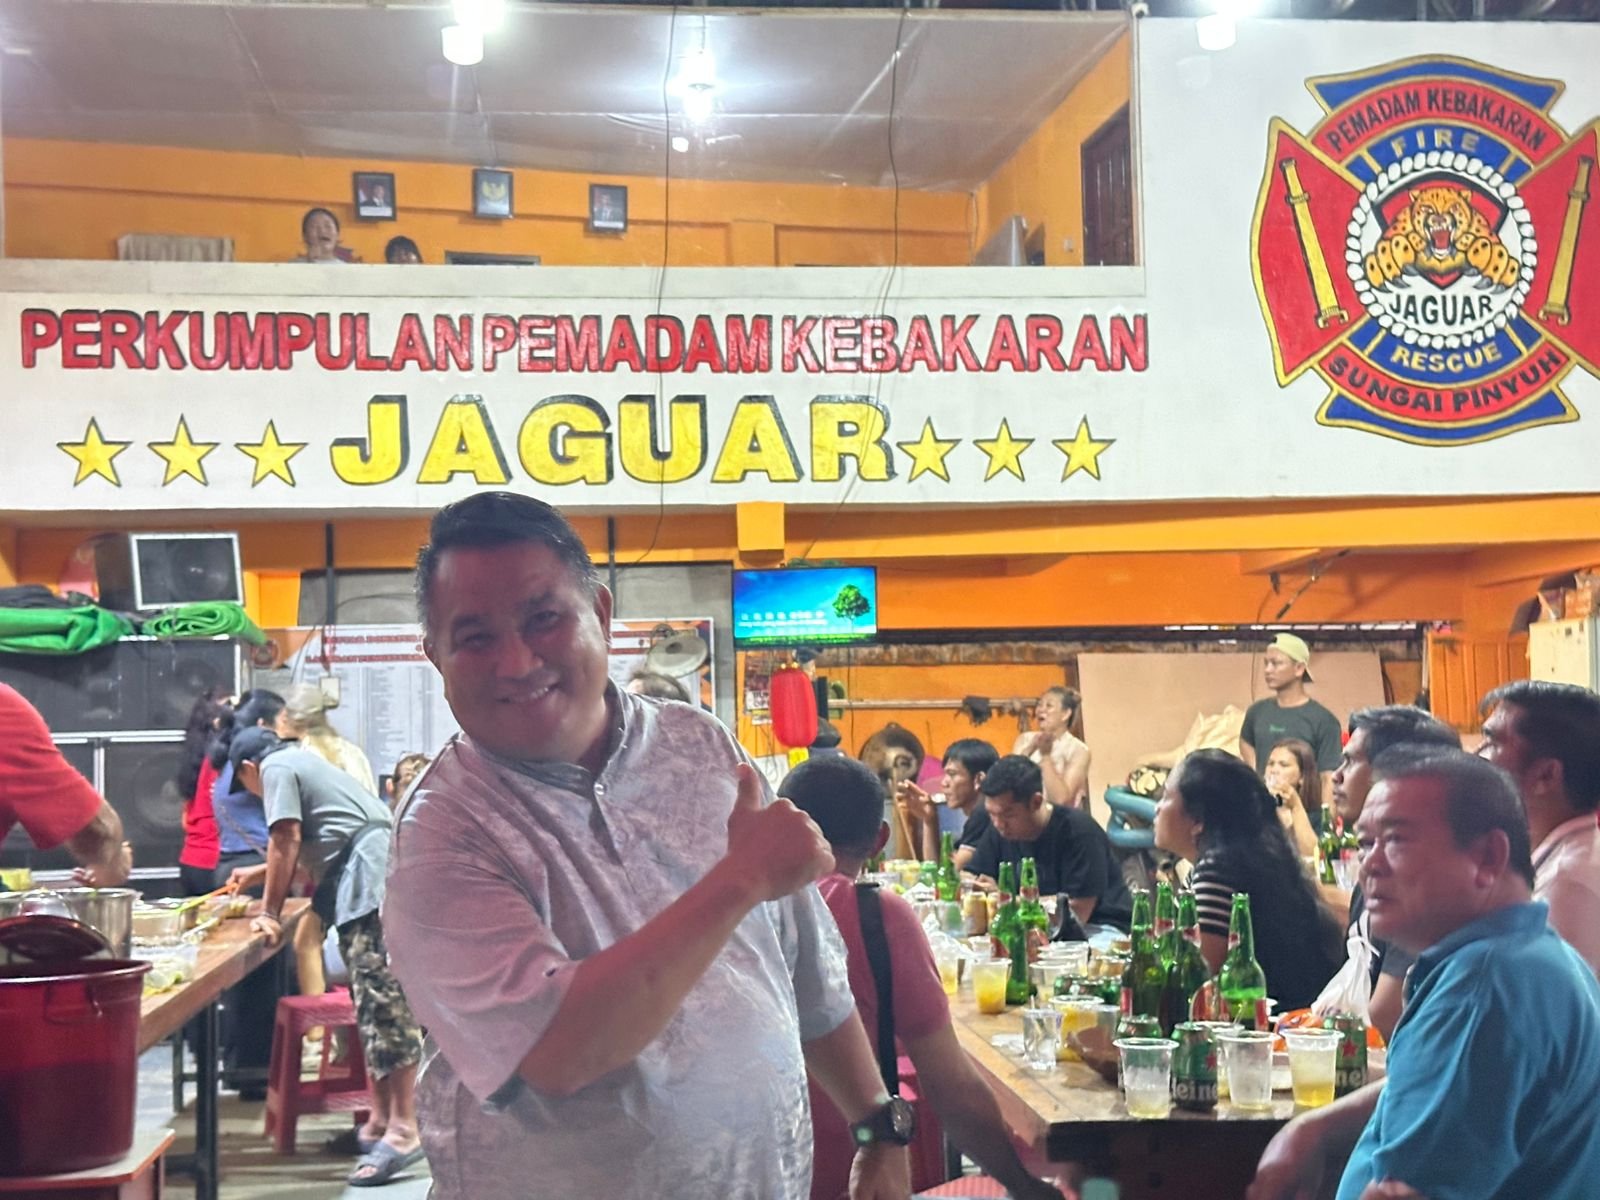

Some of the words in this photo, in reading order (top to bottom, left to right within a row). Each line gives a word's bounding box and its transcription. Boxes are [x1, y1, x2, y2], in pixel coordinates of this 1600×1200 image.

[1327, 88, 1421, 153] PEMADAM
[1427, 88, 1546, 151] KEBAKARAN
[1391, 129, 1479, 157] FIRE
[21, 308, 473, 371] PERKUMPULAN
[482, 314, 771, 373] PEMADAM
[781, 313, 1149, 371] KEBAKARAN
[1390, 292, 1494, 326] JAGUAR
[1328, 356, 1442, 412] SUNGAI
[1453, 349, 1561, 412] PINYUH
[1391, 344, 1502, 372] RESCUE
[330, 394, 898, 485] JAGUAR
